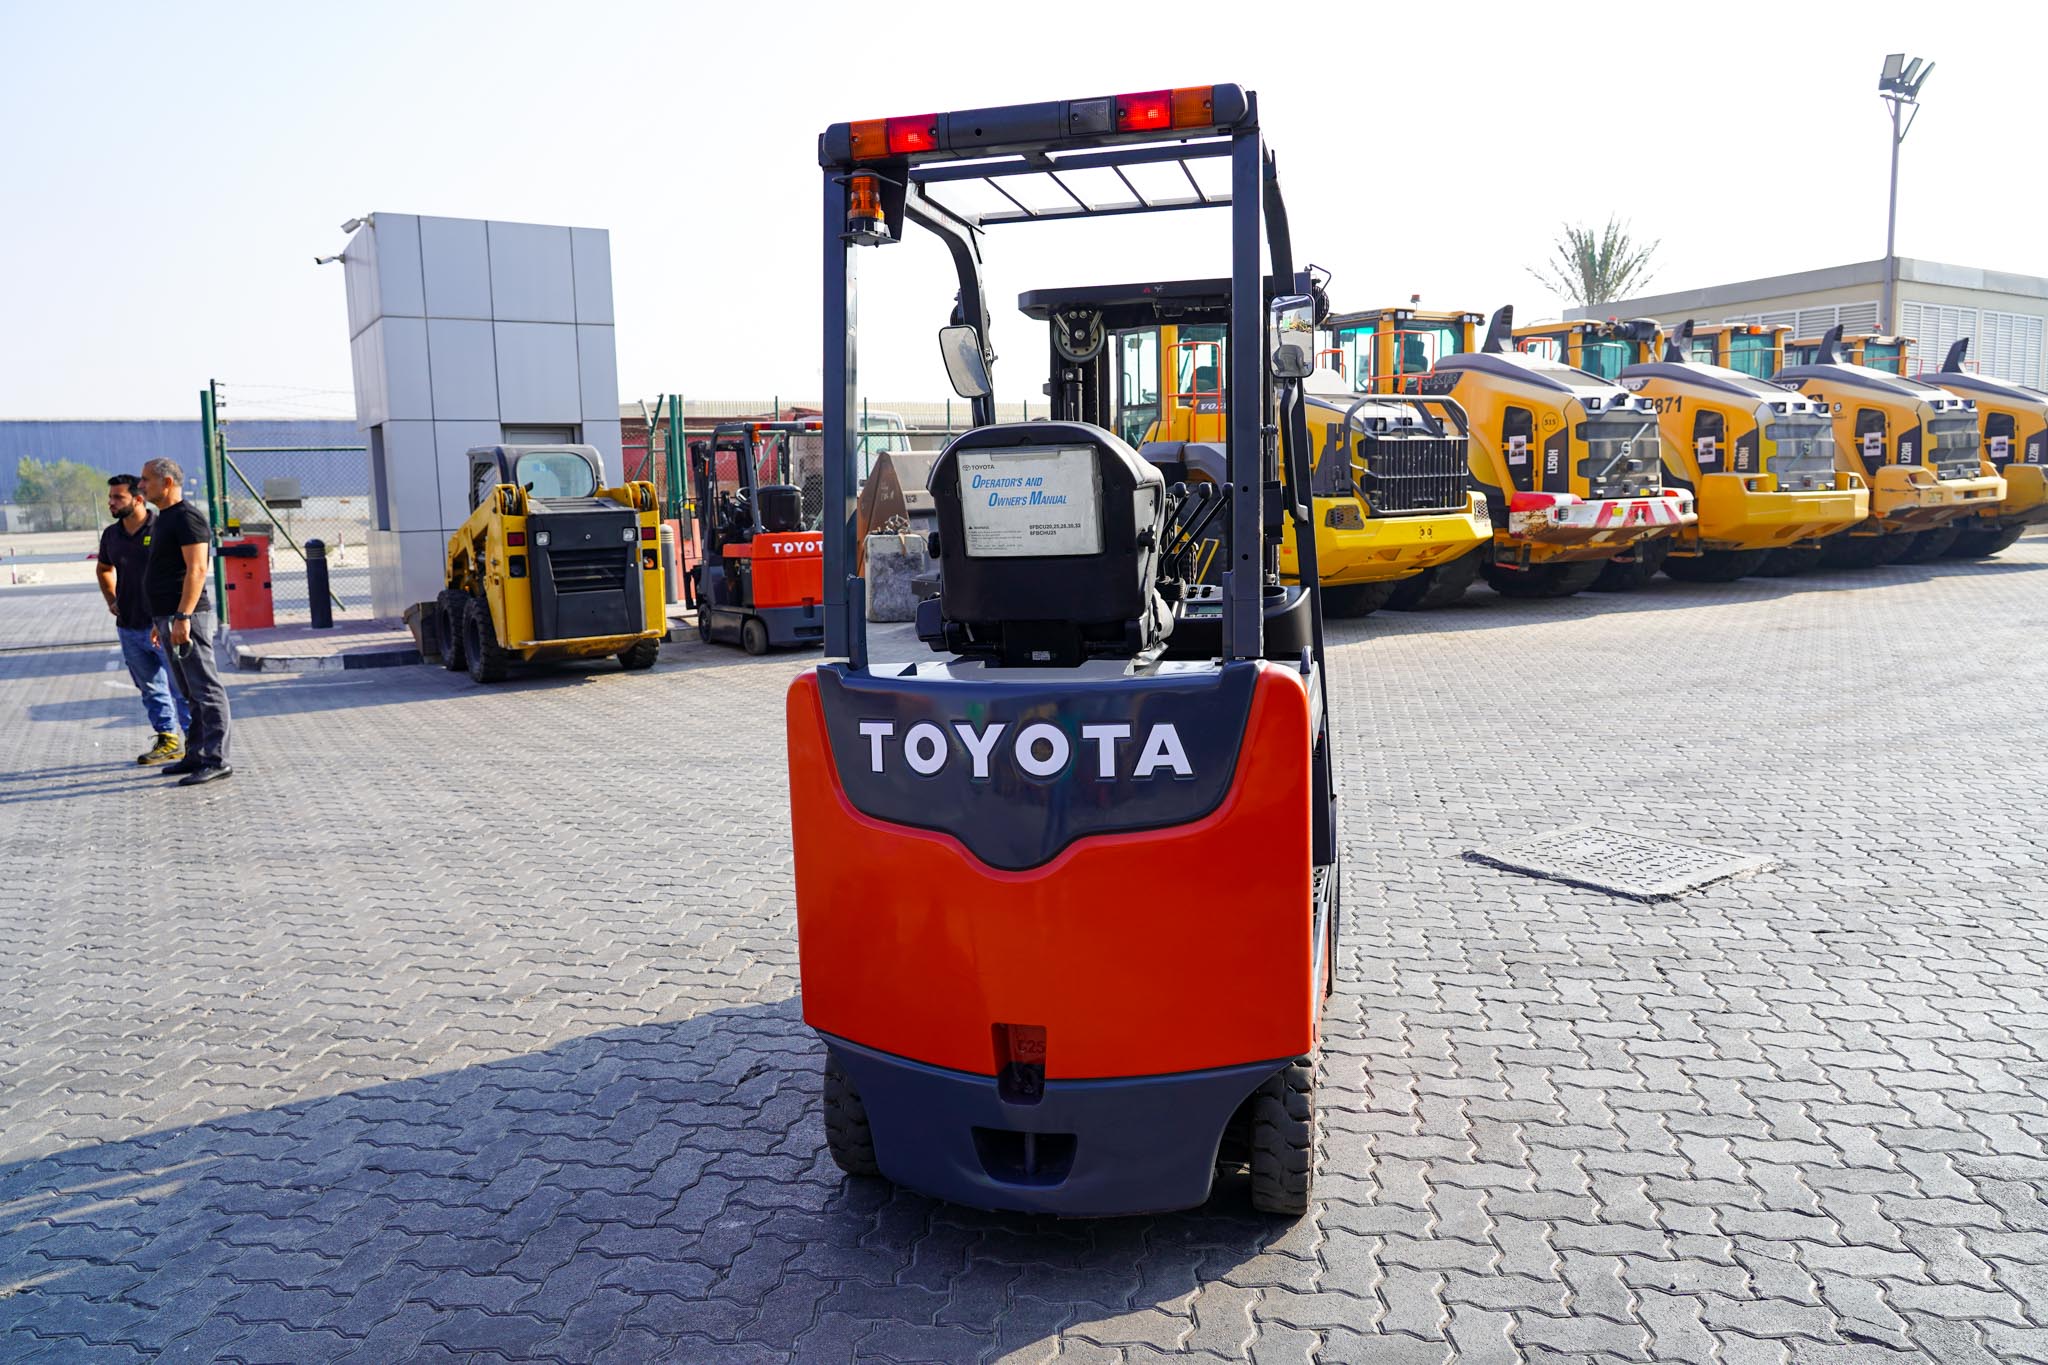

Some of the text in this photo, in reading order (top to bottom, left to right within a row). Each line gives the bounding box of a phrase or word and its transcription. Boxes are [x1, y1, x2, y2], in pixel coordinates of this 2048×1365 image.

[1655, 396, 1682, 414] 871
[1547, 449, 1559, 474] L150H
[972, 474, 1043, 489] OPERATOR'S AND
[988, 491, 1067, 507] OWNER'S MANUAL
[859, 722, 1193, 777] TOYOTA
